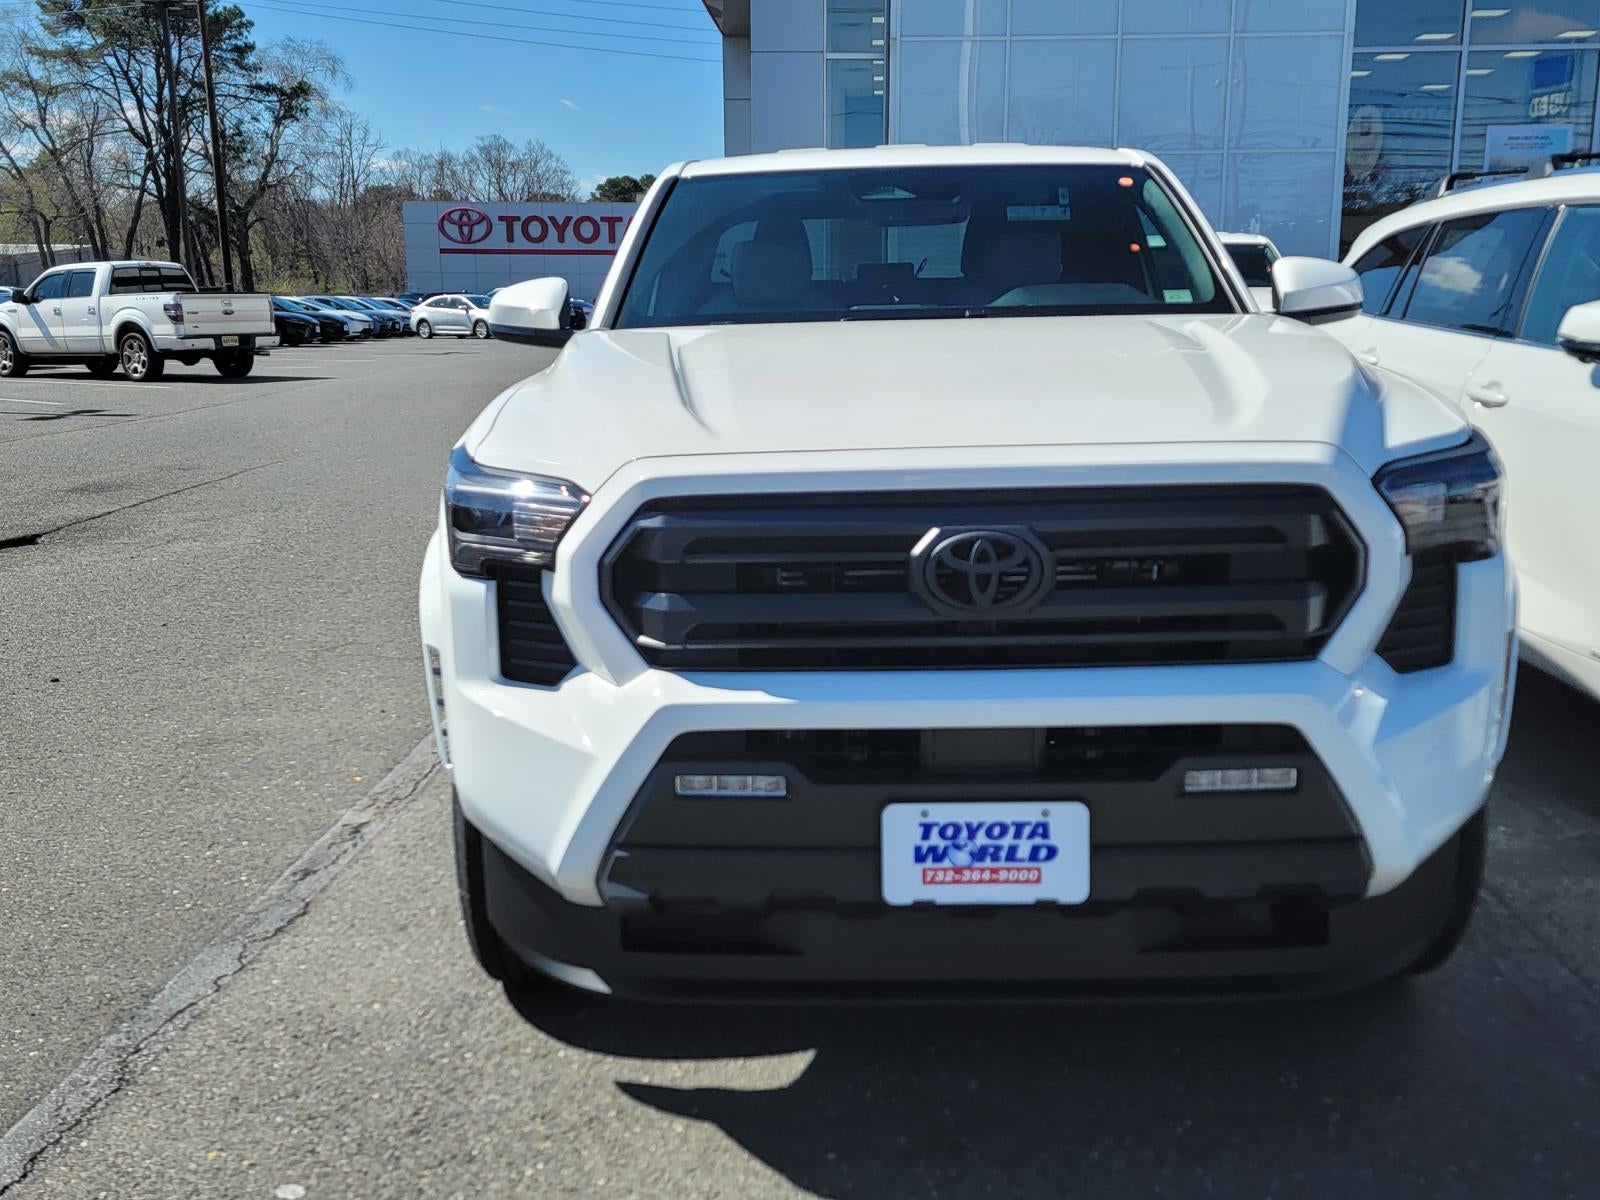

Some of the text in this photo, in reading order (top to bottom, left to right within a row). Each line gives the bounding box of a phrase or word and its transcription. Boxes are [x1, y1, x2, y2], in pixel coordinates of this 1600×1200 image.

[498, 215, 633, 244] TOYOT
[919, 821, 1051, 840] TOYOTA
[914, 842, 1060, 865] WORLD
[925, 869, 1039, 883] 732-364-9000
